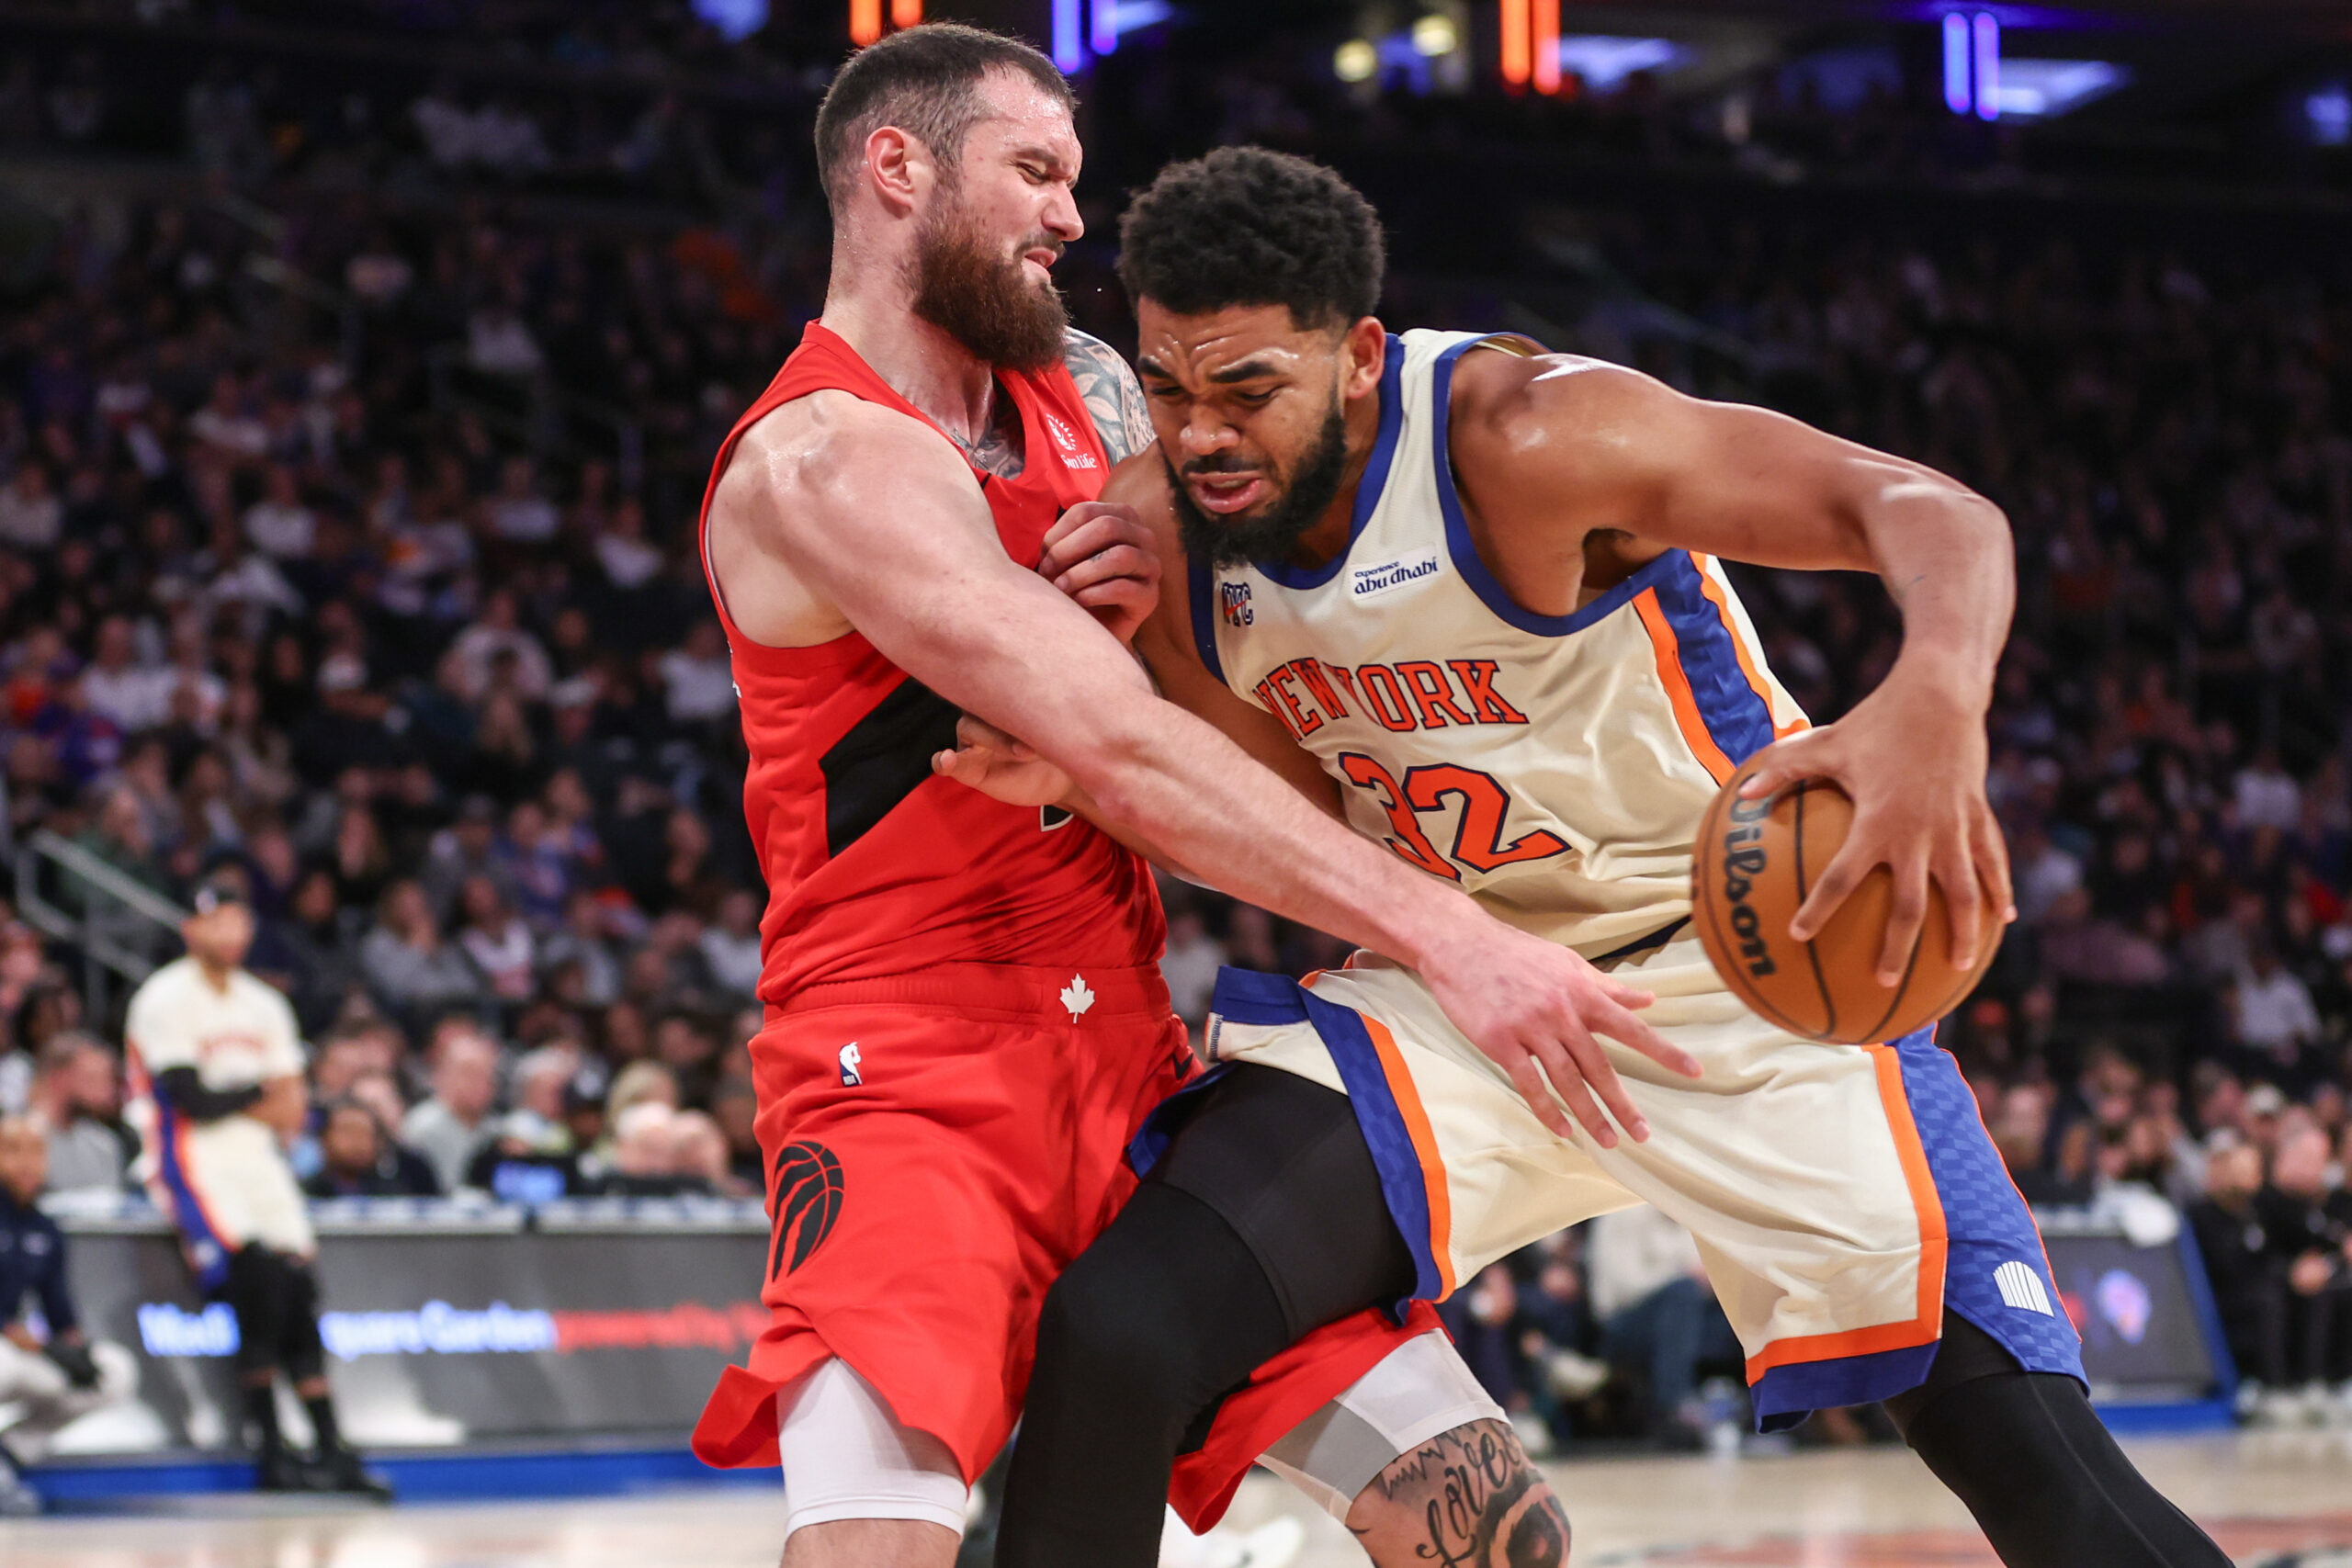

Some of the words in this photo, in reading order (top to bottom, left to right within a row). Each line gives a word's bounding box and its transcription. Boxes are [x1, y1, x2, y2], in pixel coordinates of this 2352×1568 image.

[1076, 452, 1098, 468] Life
[1354, 560, 1400, 579] experience
[1354, 577, 1388, 595] abu
[1390, 556, 1439, 585] dhabi
[1252, 656, 1351, 742] NEW
[1321, 659, 1531, 732] YORK
[1338, 750, 1573, 883] 32
